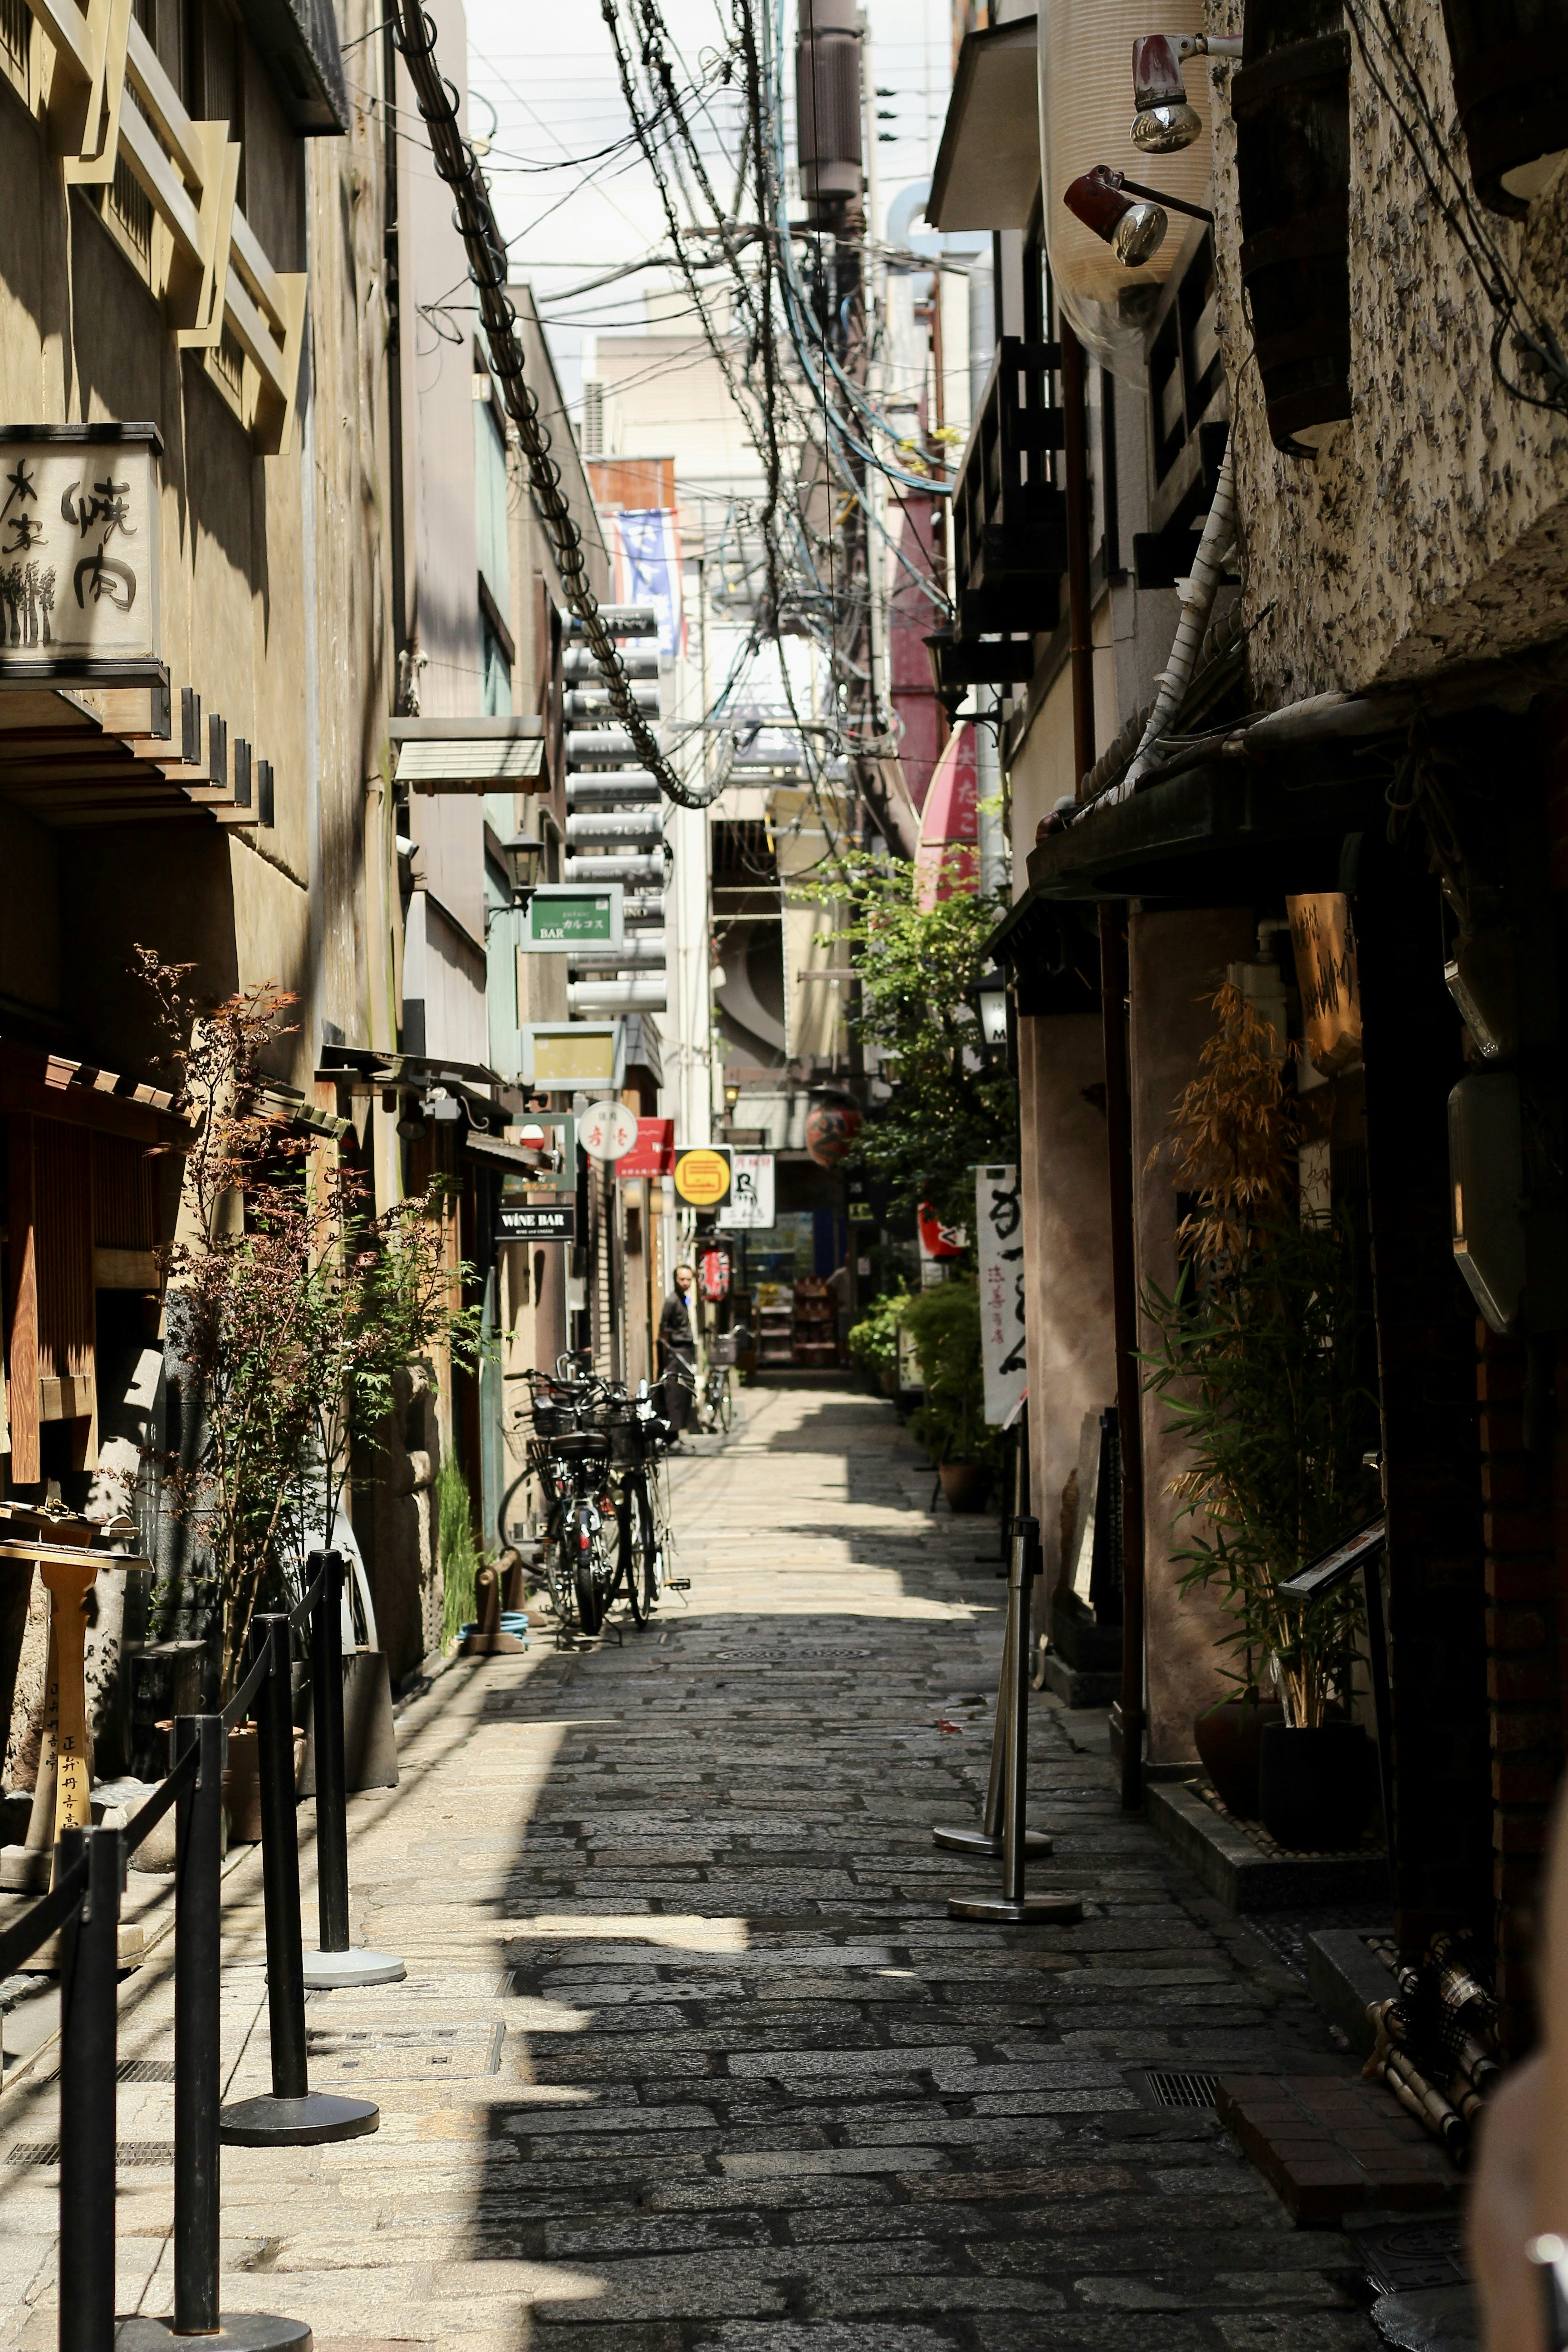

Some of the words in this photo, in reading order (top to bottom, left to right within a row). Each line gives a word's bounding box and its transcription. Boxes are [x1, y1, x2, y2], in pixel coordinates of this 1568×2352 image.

[61, 476, 138, 612] 焼肉
[562, 919, 604, 930] カルコス
[539, 928, 564, 939] BAR
[538, 1214, 564, 1226] BAR
